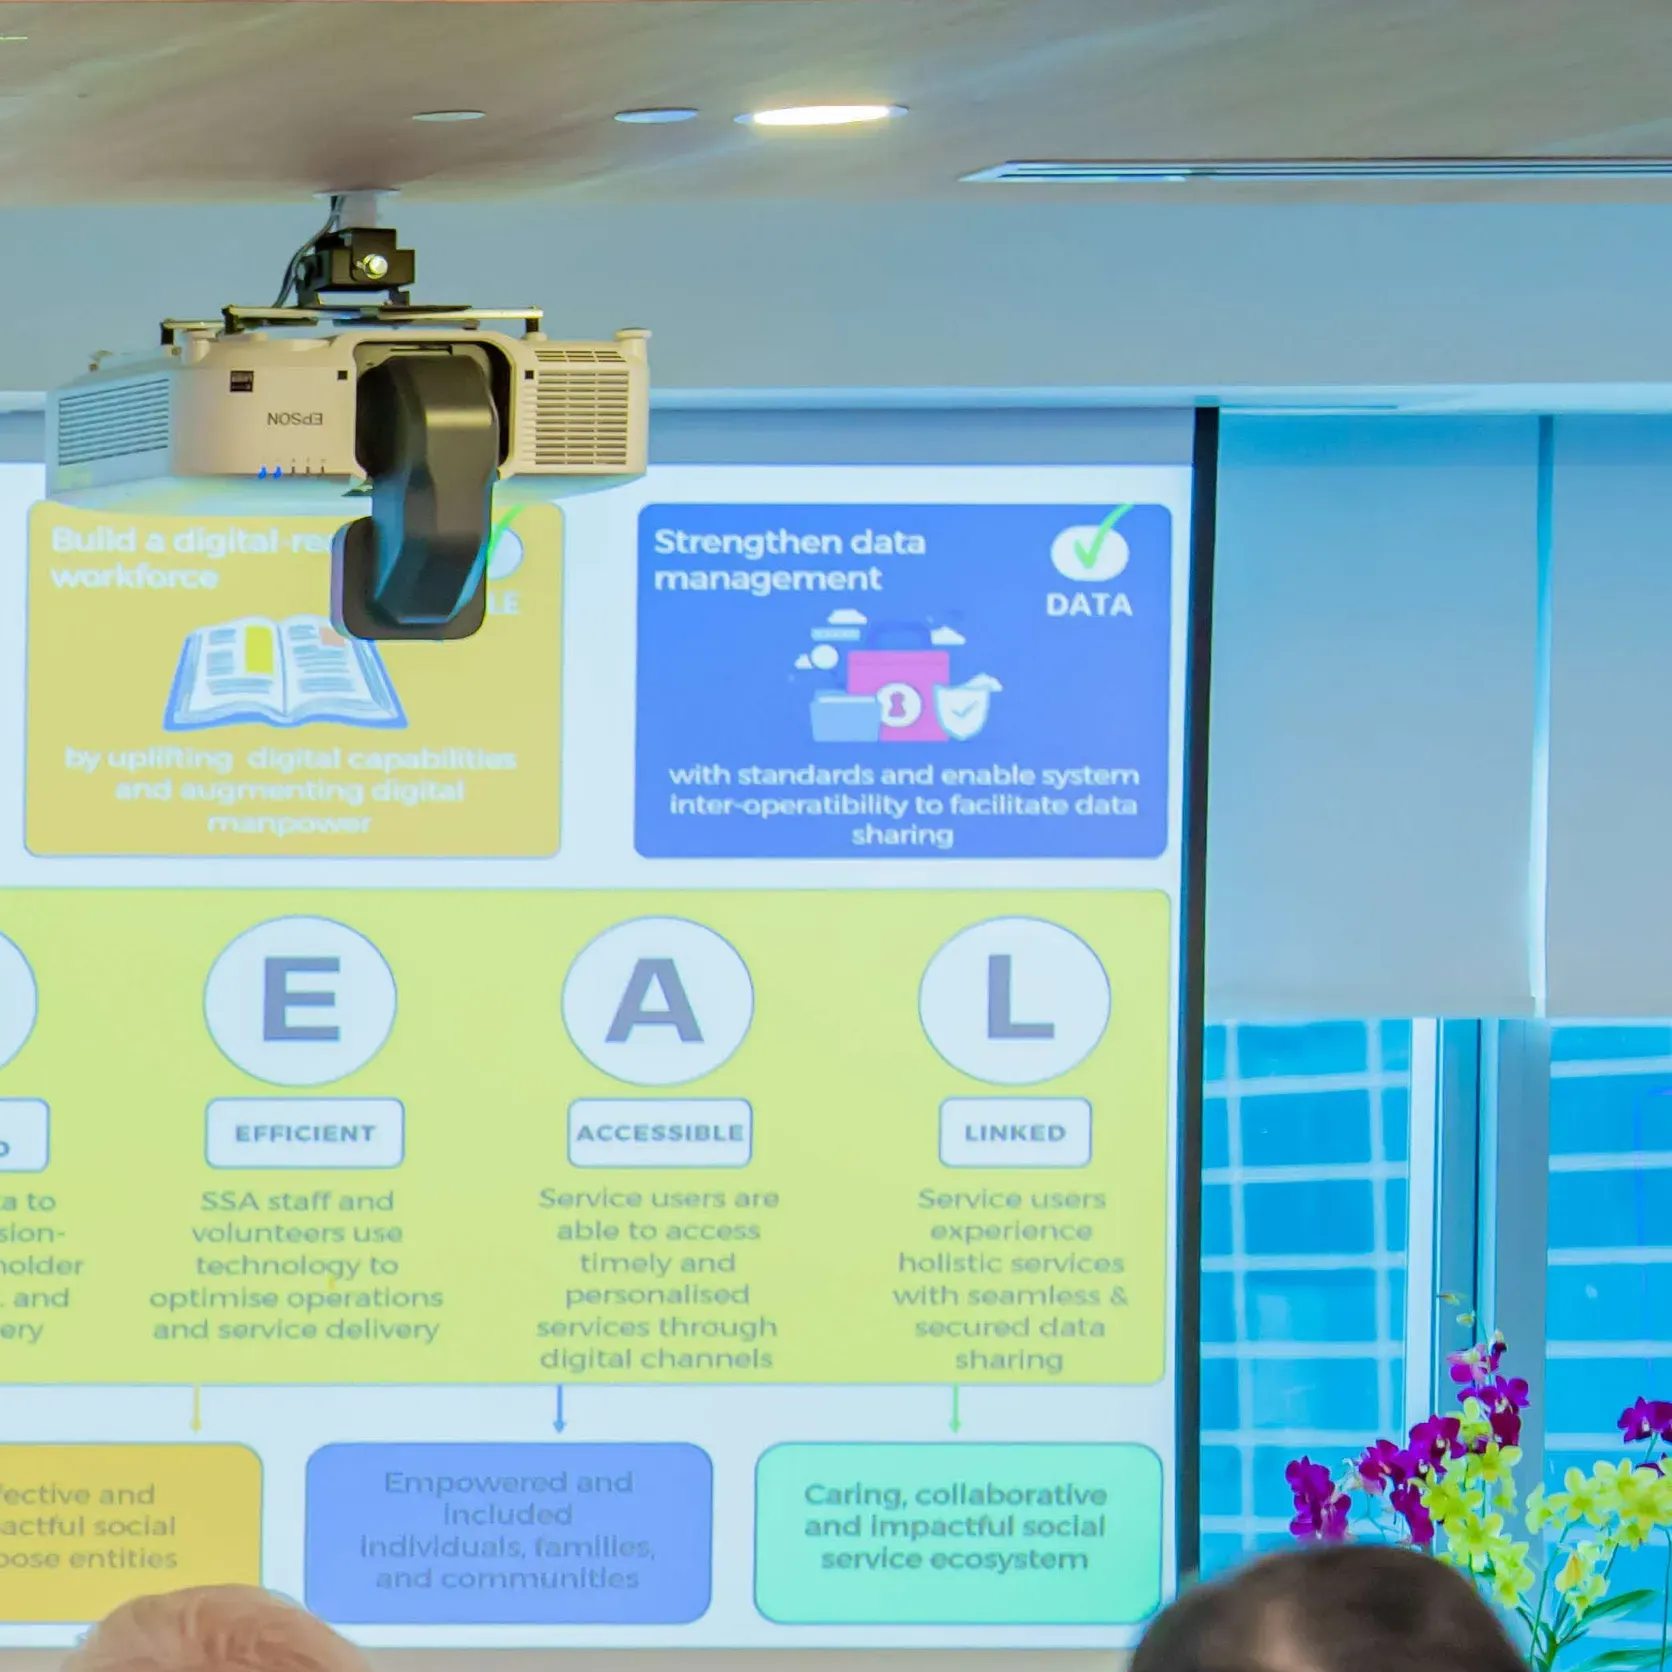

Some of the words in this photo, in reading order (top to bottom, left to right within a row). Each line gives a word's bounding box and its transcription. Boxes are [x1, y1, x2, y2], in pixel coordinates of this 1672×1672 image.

[268, 412, 323, 425] EPSON
[654, 528, 844, 562] Strengthen
[849, 528, 927, 556] data
[654, 567, 883, 598] management
[1046, 593, 1133, 618] DATA
[668, 764, 731, 787] with
[737, 764, 875, 787] standards
[880, 764, 934, 787] and
[940, 763, 1037, 787] enable
[1041, 765, 1141, 792] system
[669, 794, 909, 821] inter-operatibility
[914, 796, 944, 816] to
[949, 794, 1070, 817] facilitate
[1074, 794, 1139, 817] data
[852, 823, 955, 851] sharing
[262, 957, 341, 1044] E
[604, 958, 705, 1045] A
[987, 954, 1056, 1041] L
[235, 1125, 376, 1144] EFFICIENT
[576, 1124, 744, 1144] ACCESSIBLE
[965, 1125, 1067, 1144] LINKED
[26, 1193, 57, 1214] to
[200, 1190, 261, 1214] SSA
[267, 1191, 333, 1213] staff
[338, 1190, 395, 1213] and
[538, 1187, 643, 1211] Service
[650, 1192, 727, 1210] users
[733, 1192, 780, 1210] are
[917, 1188, 1023, 1212] Service
[1028, 1193, 1107, 1211] users
[191, 1222, 346, 1245] volunteers
[352, 1226, 404, 1245] use
[556, 1220, 620, 1243] able
[628, 1221, 658, 1243] to
[665, 1224, 762, 1243] access
[930, 1220, 1094, 1247] experience
[195, 1254, 361, 1286] technology
[369, 1256, 400, 1277] to
[579, 1252, 673, 1280] timely
[679, 1252, 736, 1275] and
[897, 1252, 1003, 1275] holistic
[1010, 1252, 1126, 1275] services
[13, 1288, 70, 1310] and
[148, 1287, 280, 1314] optimise
[285, 1287, 444, 1316] operations
[564, 1284, 750, 1312] personalised
[891, 1285, 960, 1308] with
[967, 1284, 1101, 1308] seamless
[1109, 1286, 1129, 1308] &
[152, 1318, 210, 1342] and
[217, 1318, 318, 1342] service
[324, 1318, 440, 1346] delivery
[536, 1316, 651, 1339] services
[658, 1316, 778, 1344] through
[914, 1316, 1031, 1339] secured
[1038, 1316, 1106, 1339] data
[539, 1348, 632, 1376] digital
[639, 1348, 774, 1371] channels
[955, 1349, 1064, 1377] sharing
[98, 1483, 156, 1507] and
[804, 1482, 908, 1512] Caring,
[914, 1482, 1108, 1508] collaborative
[93, 1515, 176, 1538] social
[804, 1515, 862, 1539] and
[871, 1514, 1015, 1544] impactful
[1022, 1514, 1107, 1540] social
[68, 1547, 178, 1571] entities
[821, 1546, 924, 1572] service
[929, 1549, 1090, 1577] ecosystem
